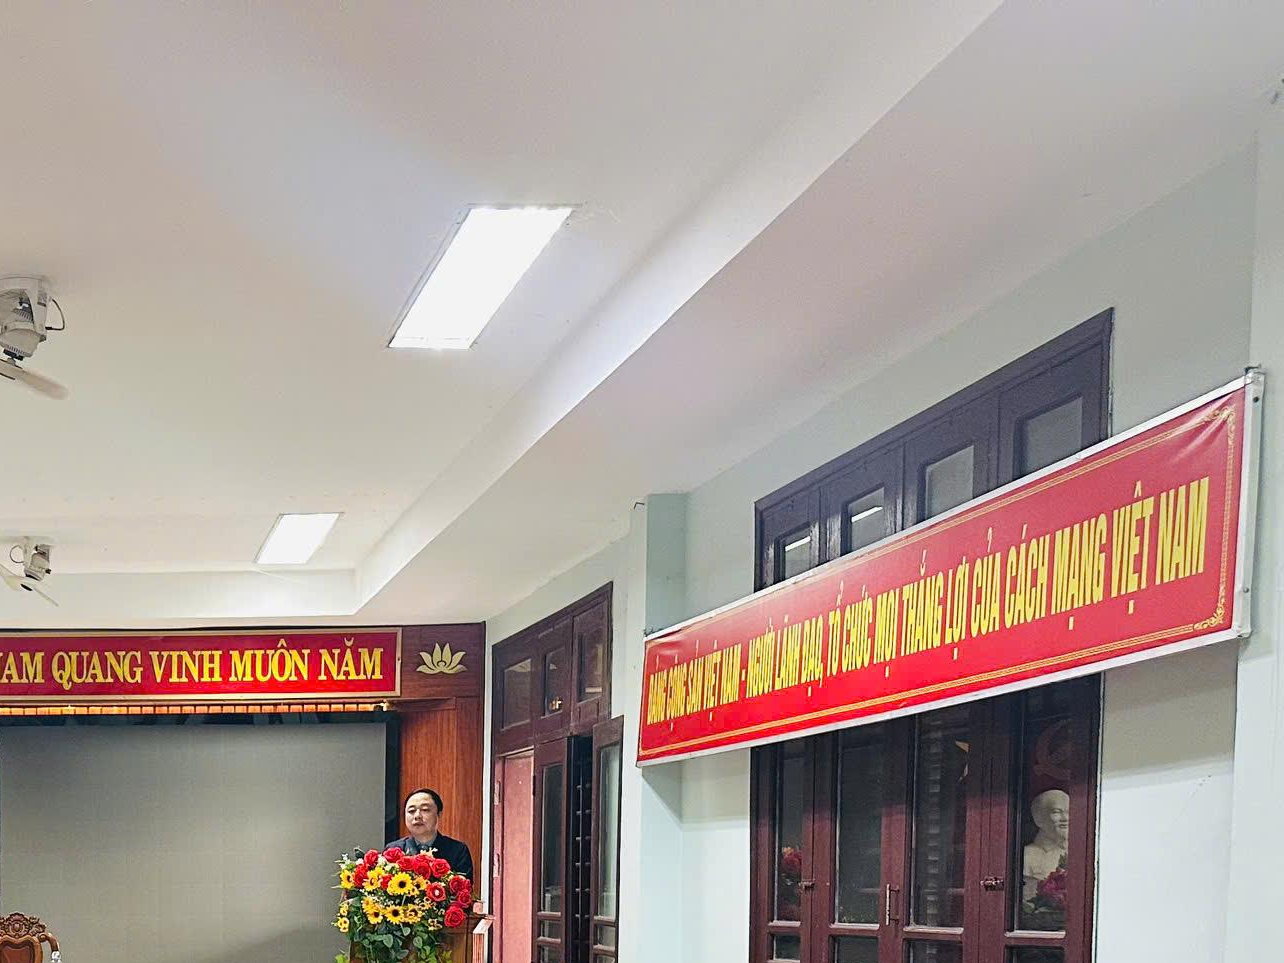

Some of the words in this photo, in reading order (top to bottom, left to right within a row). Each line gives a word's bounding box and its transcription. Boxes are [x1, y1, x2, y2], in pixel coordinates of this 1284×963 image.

[51, 651, 143, 690] QUANG
[148, 650, 223, 682] VINH
[229, 639, 310, 681] MUÔN
[318, 637, 384, 680] NĂM
[687, 640, 704, 715] SẢN
[703, 640, 722, 721] VIỆT
[720, 643, 742, 705] NAM
[746, 616, 774, 697] NGƯỜI
[775, 615, 802, 690] LÃNH
[801, 614, 824, 697] ĐẠO,
[826, 581, 842, 675] TỔ
[842, 585, 873, 673] CHỨC
[873, 586, 899, 677] MỌI
[901, 549, 944, 656] THẮNG
[945, 560, 970, 660] LỢI
[970, 527, 1001, 637] CỦA
[1004, 524, 1050, 629] CÁCH
[1051, 513, 1107, 630] MẠNG
[1111, 481, 1154, 614] VIỆT
[1155, 476, 1210, 585] NAM
